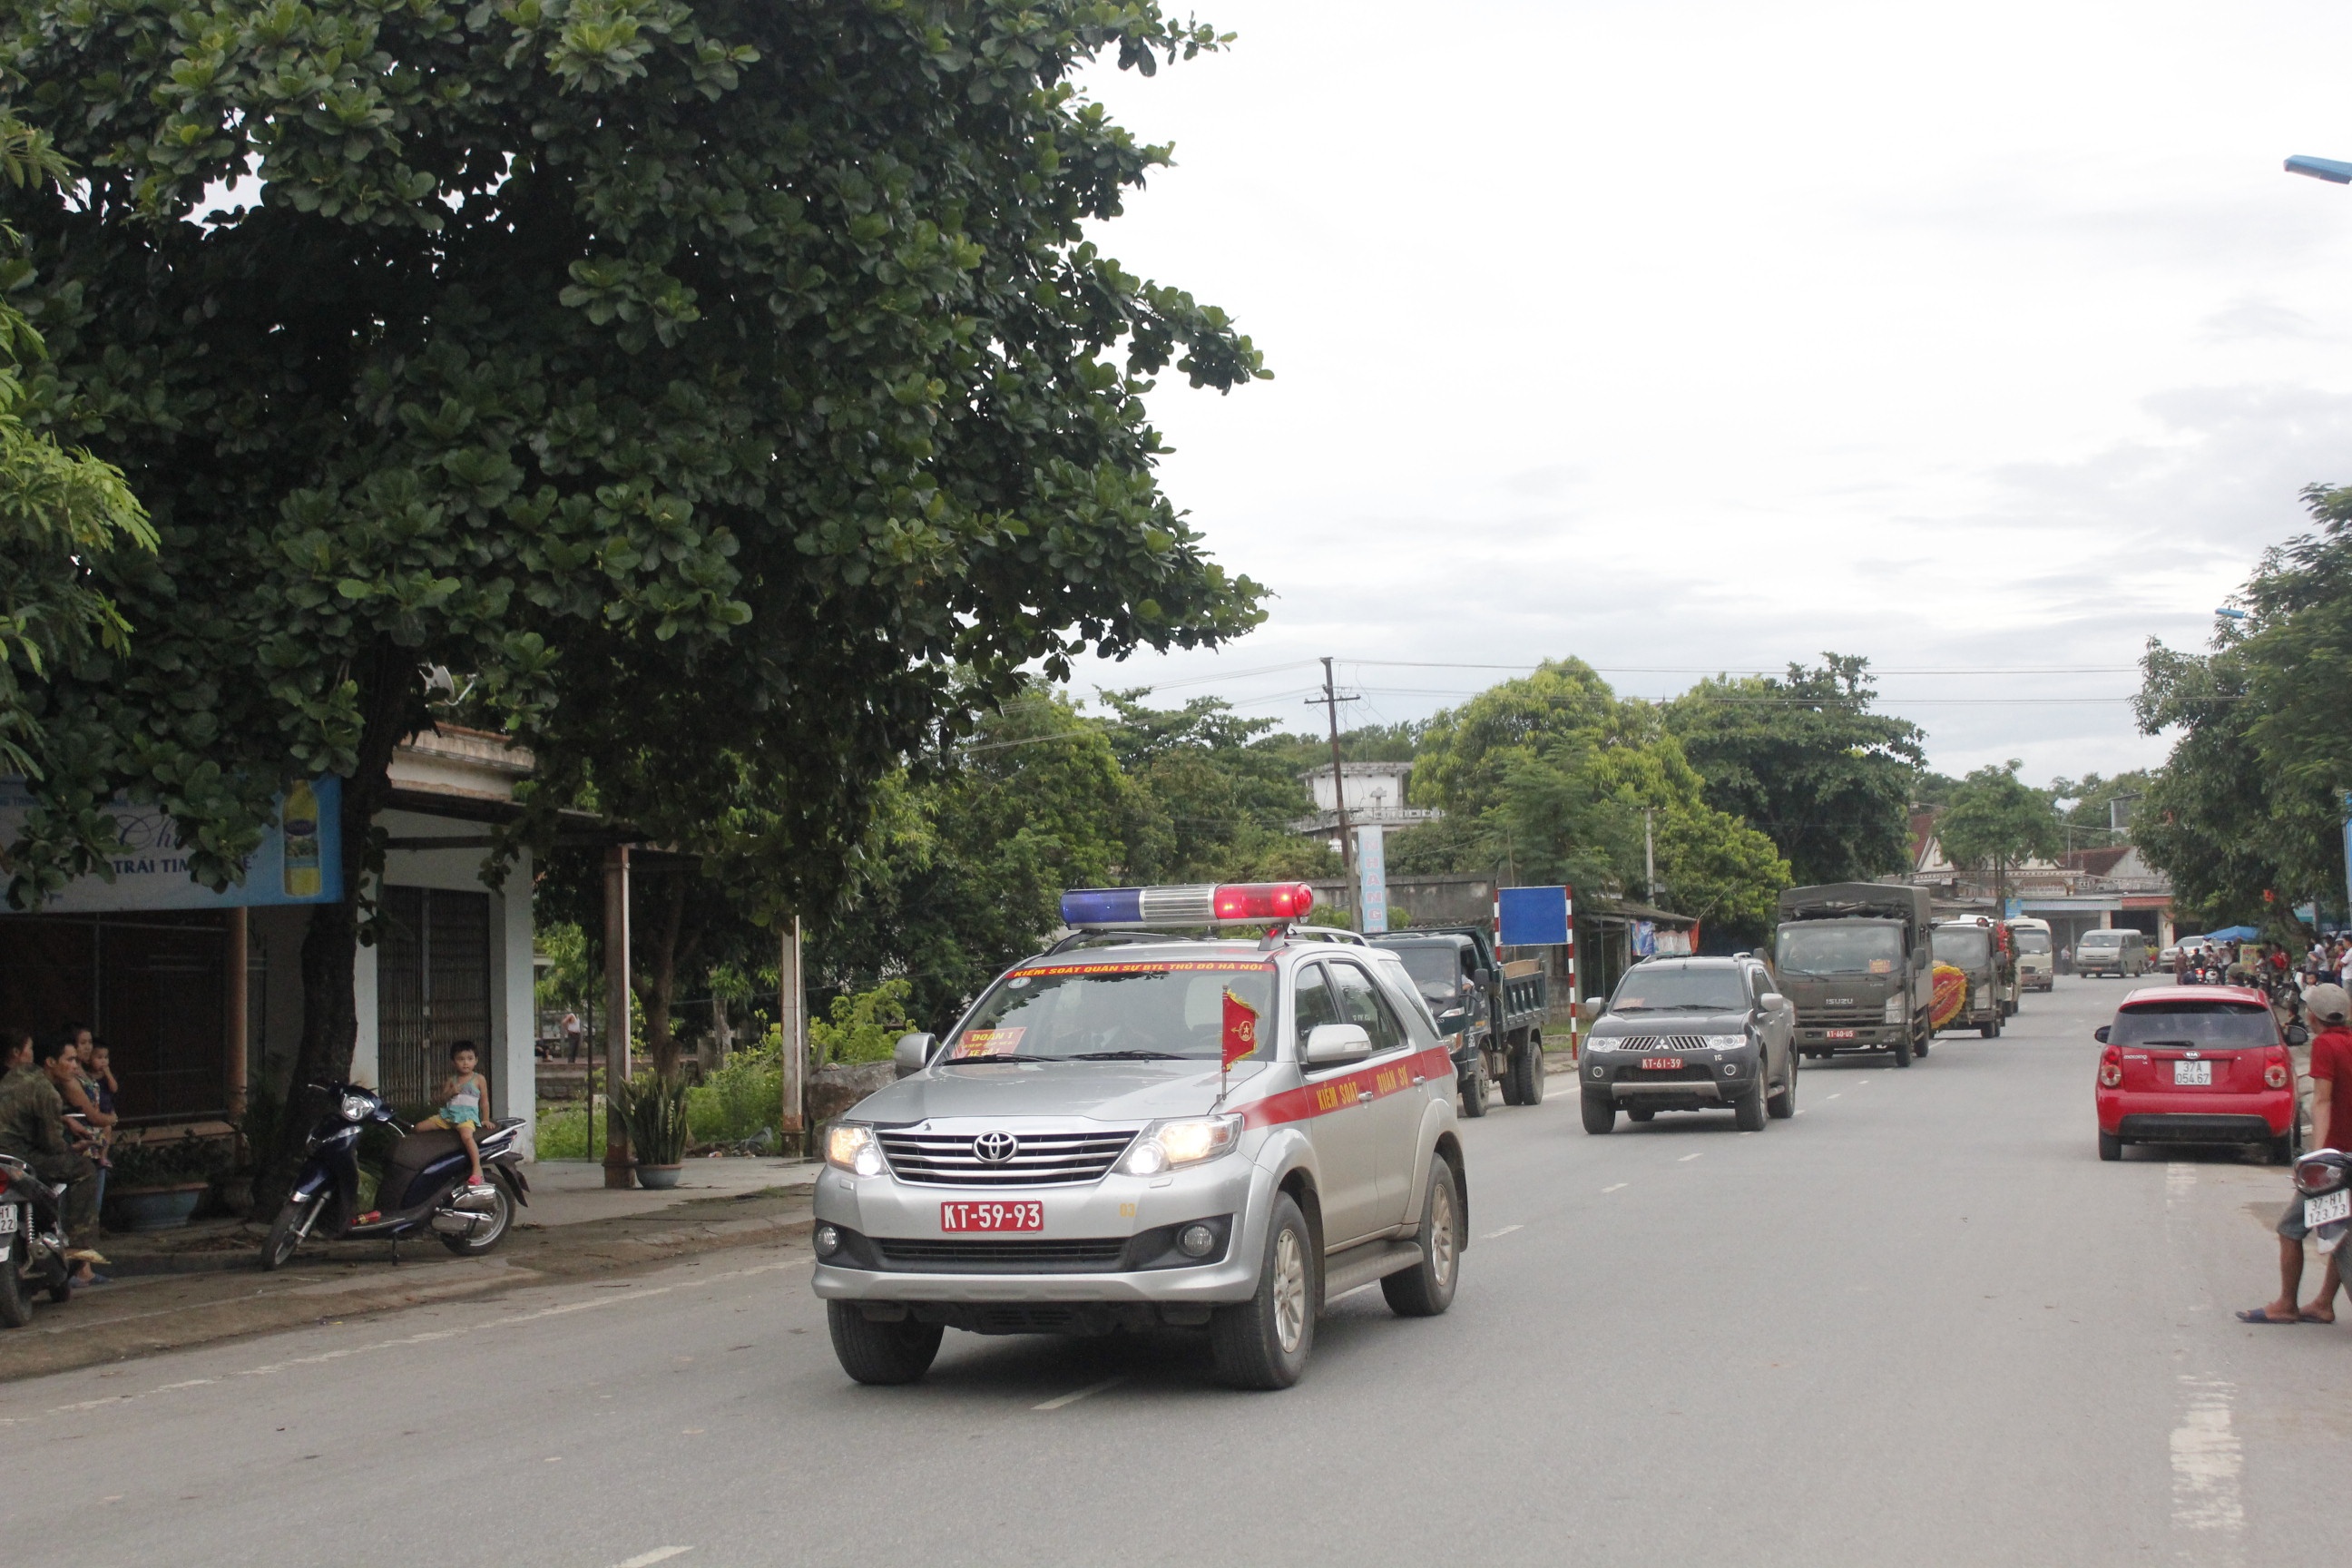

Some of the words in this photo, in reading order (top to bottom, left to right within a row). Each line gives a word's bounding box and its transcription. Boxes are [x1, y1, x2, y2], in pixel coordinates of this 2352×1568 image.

[1642, 1058, 1681, 1069] KT-61-39
[2183, 1062, 2201, 1073] 37A
[2176, 1073, 2210, 1084] 054.67
[1339, 1077, 1359, 1104] SOÁT
[1120, 1202, 1134, 1218] 03
[2311, 1192, 2342, 1211] 37-H1
[945, 1203, 1040, 1229] KT-59-93
[2308, 1203, 2346, 1224] 123.73
